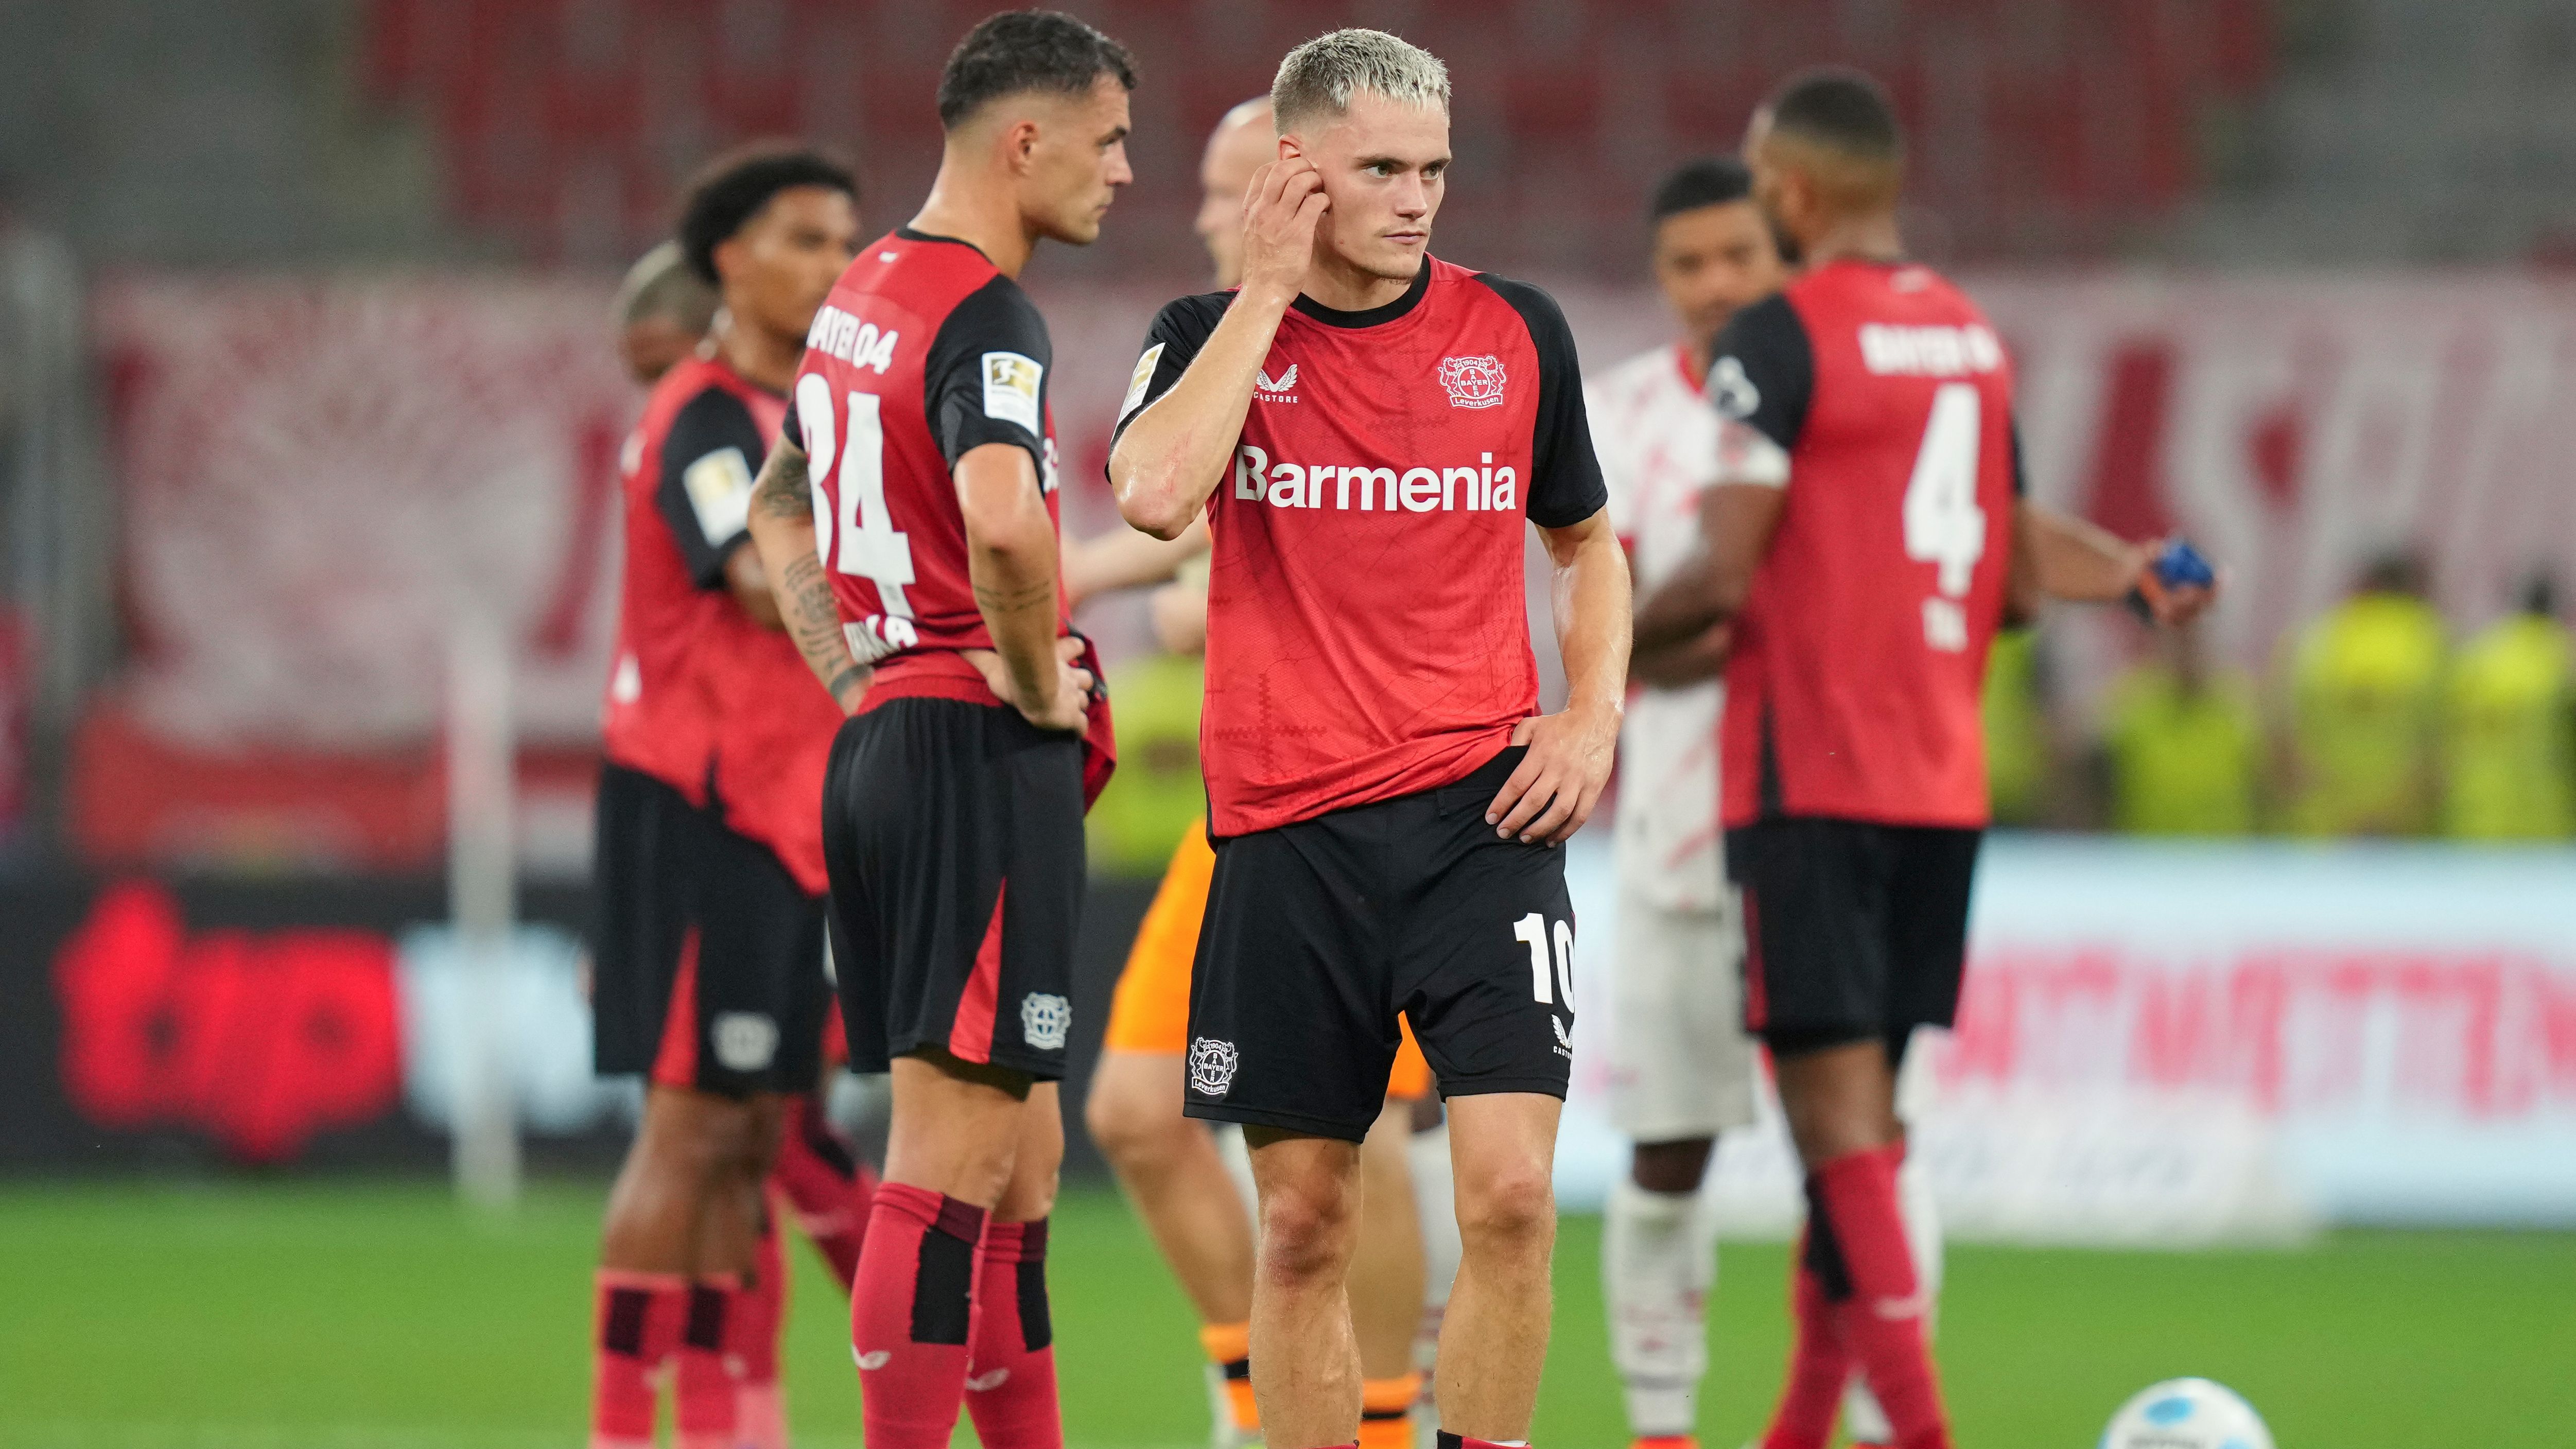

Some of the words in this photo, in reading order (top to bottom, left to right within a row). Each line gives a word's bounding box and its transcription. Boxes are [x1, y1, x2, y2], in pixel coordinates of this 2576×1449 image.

[852, 323, 899, 375] 04
[1254, 391, 1298, 404] CASTORE
[1454, 396, 1499, 407] Leverkusen
[795, 373, 915, 618] 34
[1235, 444, 1517, 512] Barmenia
[1903, 381, 1986, 599] 4
[1513, 913, 1574, 1014] 10
[1194, 1079, 1226, 1093] Leverkusen
[1204, 1062, 1224, 1073] BAYER
